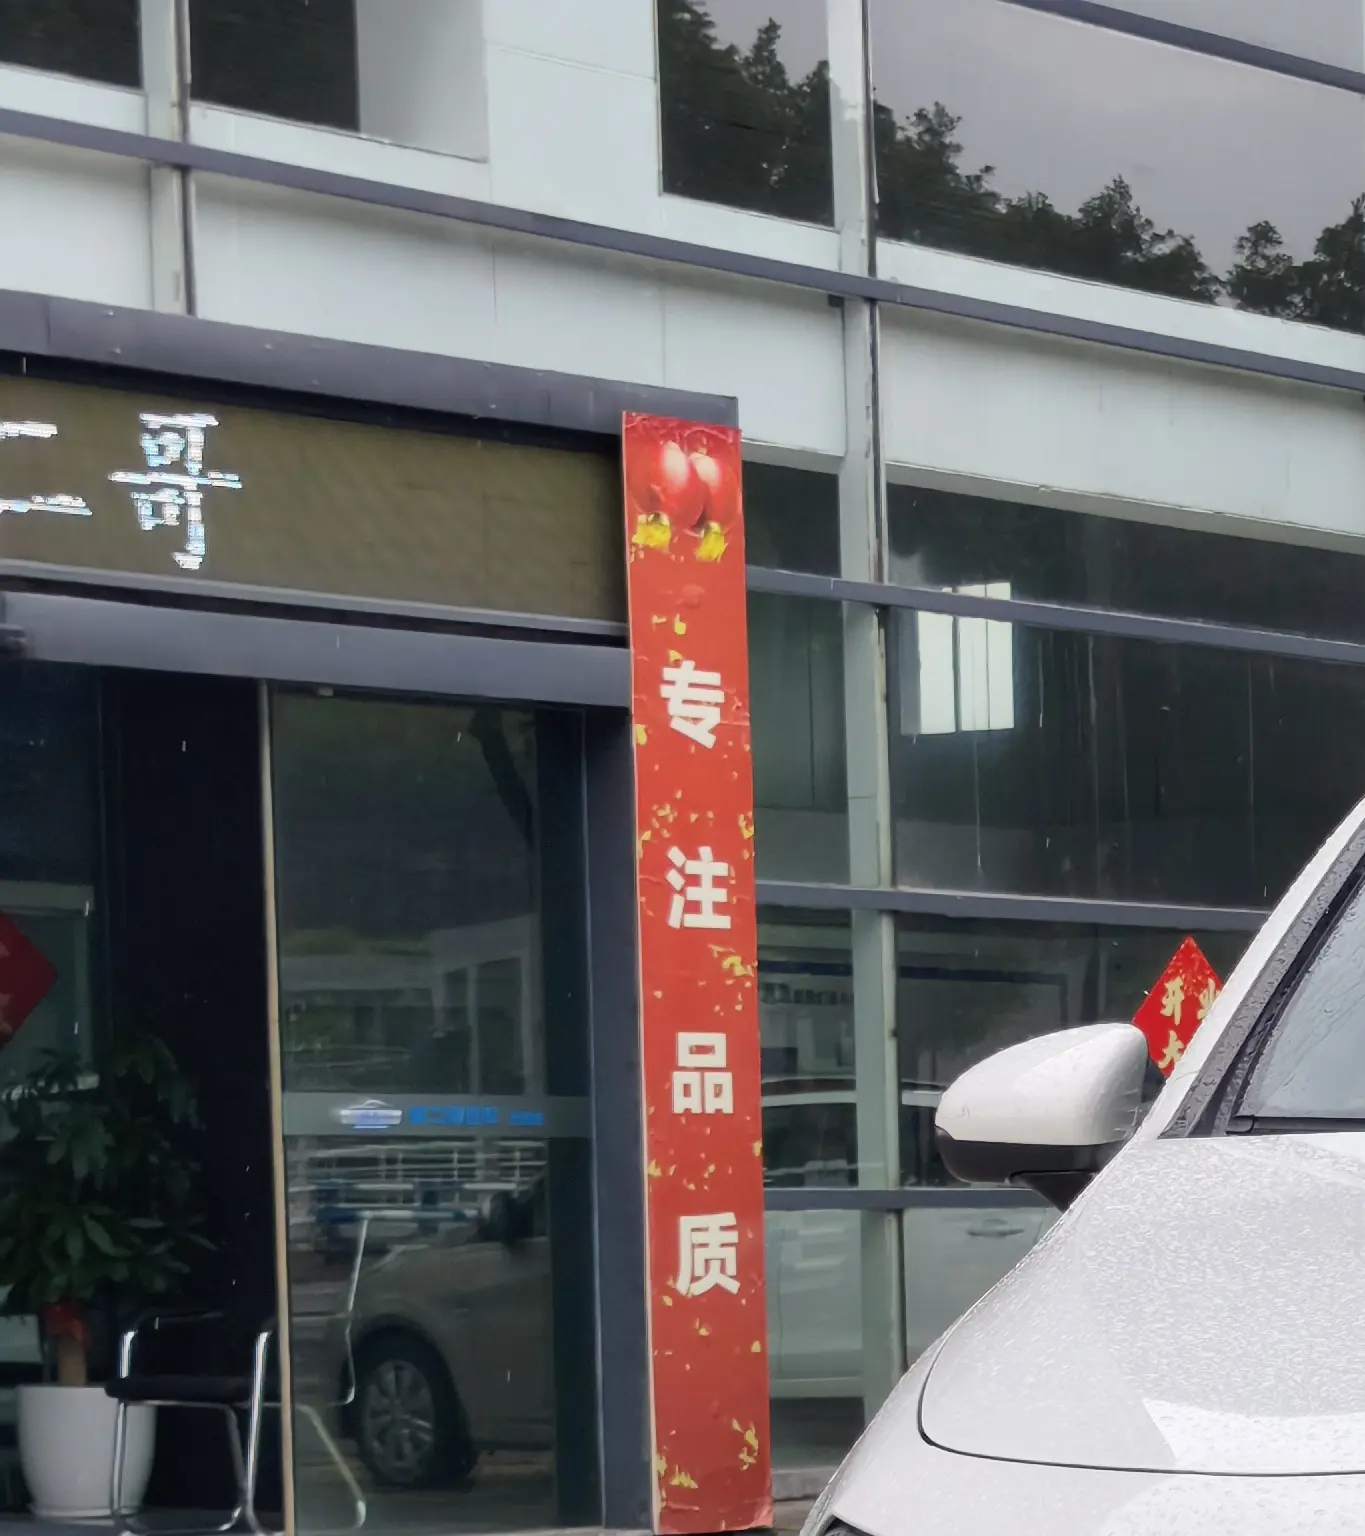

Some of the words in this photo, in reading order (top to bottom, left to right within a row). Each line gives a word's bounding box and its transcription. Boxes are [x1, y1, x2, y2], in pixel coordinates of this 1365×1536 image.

[0, 413, 243, 570] 二哥
[660, 660, 741, 1297] 专注品质
